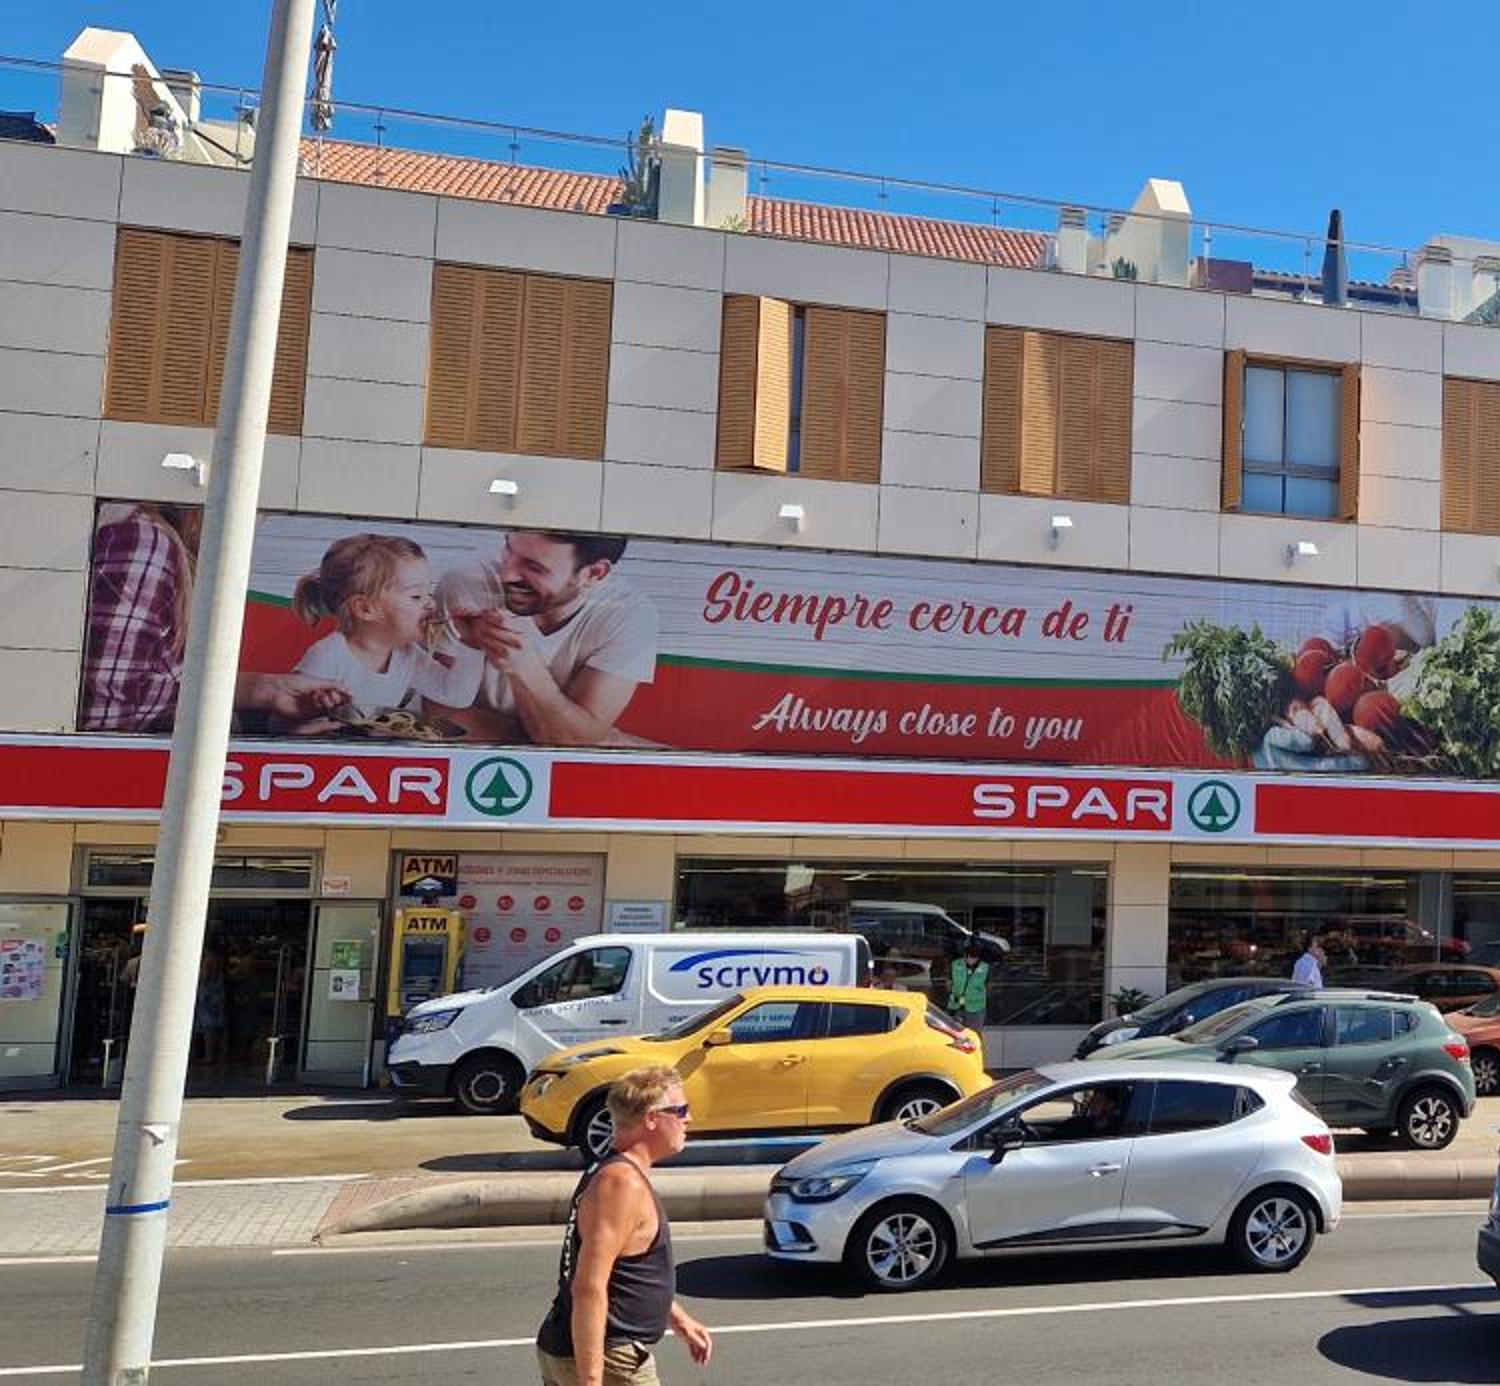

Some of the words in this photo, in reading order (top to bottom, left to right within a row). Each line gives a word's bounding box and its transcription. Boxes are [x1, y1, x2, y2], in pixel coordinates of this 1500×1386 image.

[703, 570, 895, 641] Siempre
[909, 600, 1027, 638] cerca
[1041, 599, 1091, 642] de
[1101, 602, 1136, 643] ti
[752, 692, 889, 744] Always
[899, 703, 978, 738] close
[986, 706, 1015, 738] to
[1023, 715, 1084, 750] you
[973, 785, 1168, 823] SPAR
[405, 857, 453, 875] ATM
[407, 917, 447, 930] ATM
